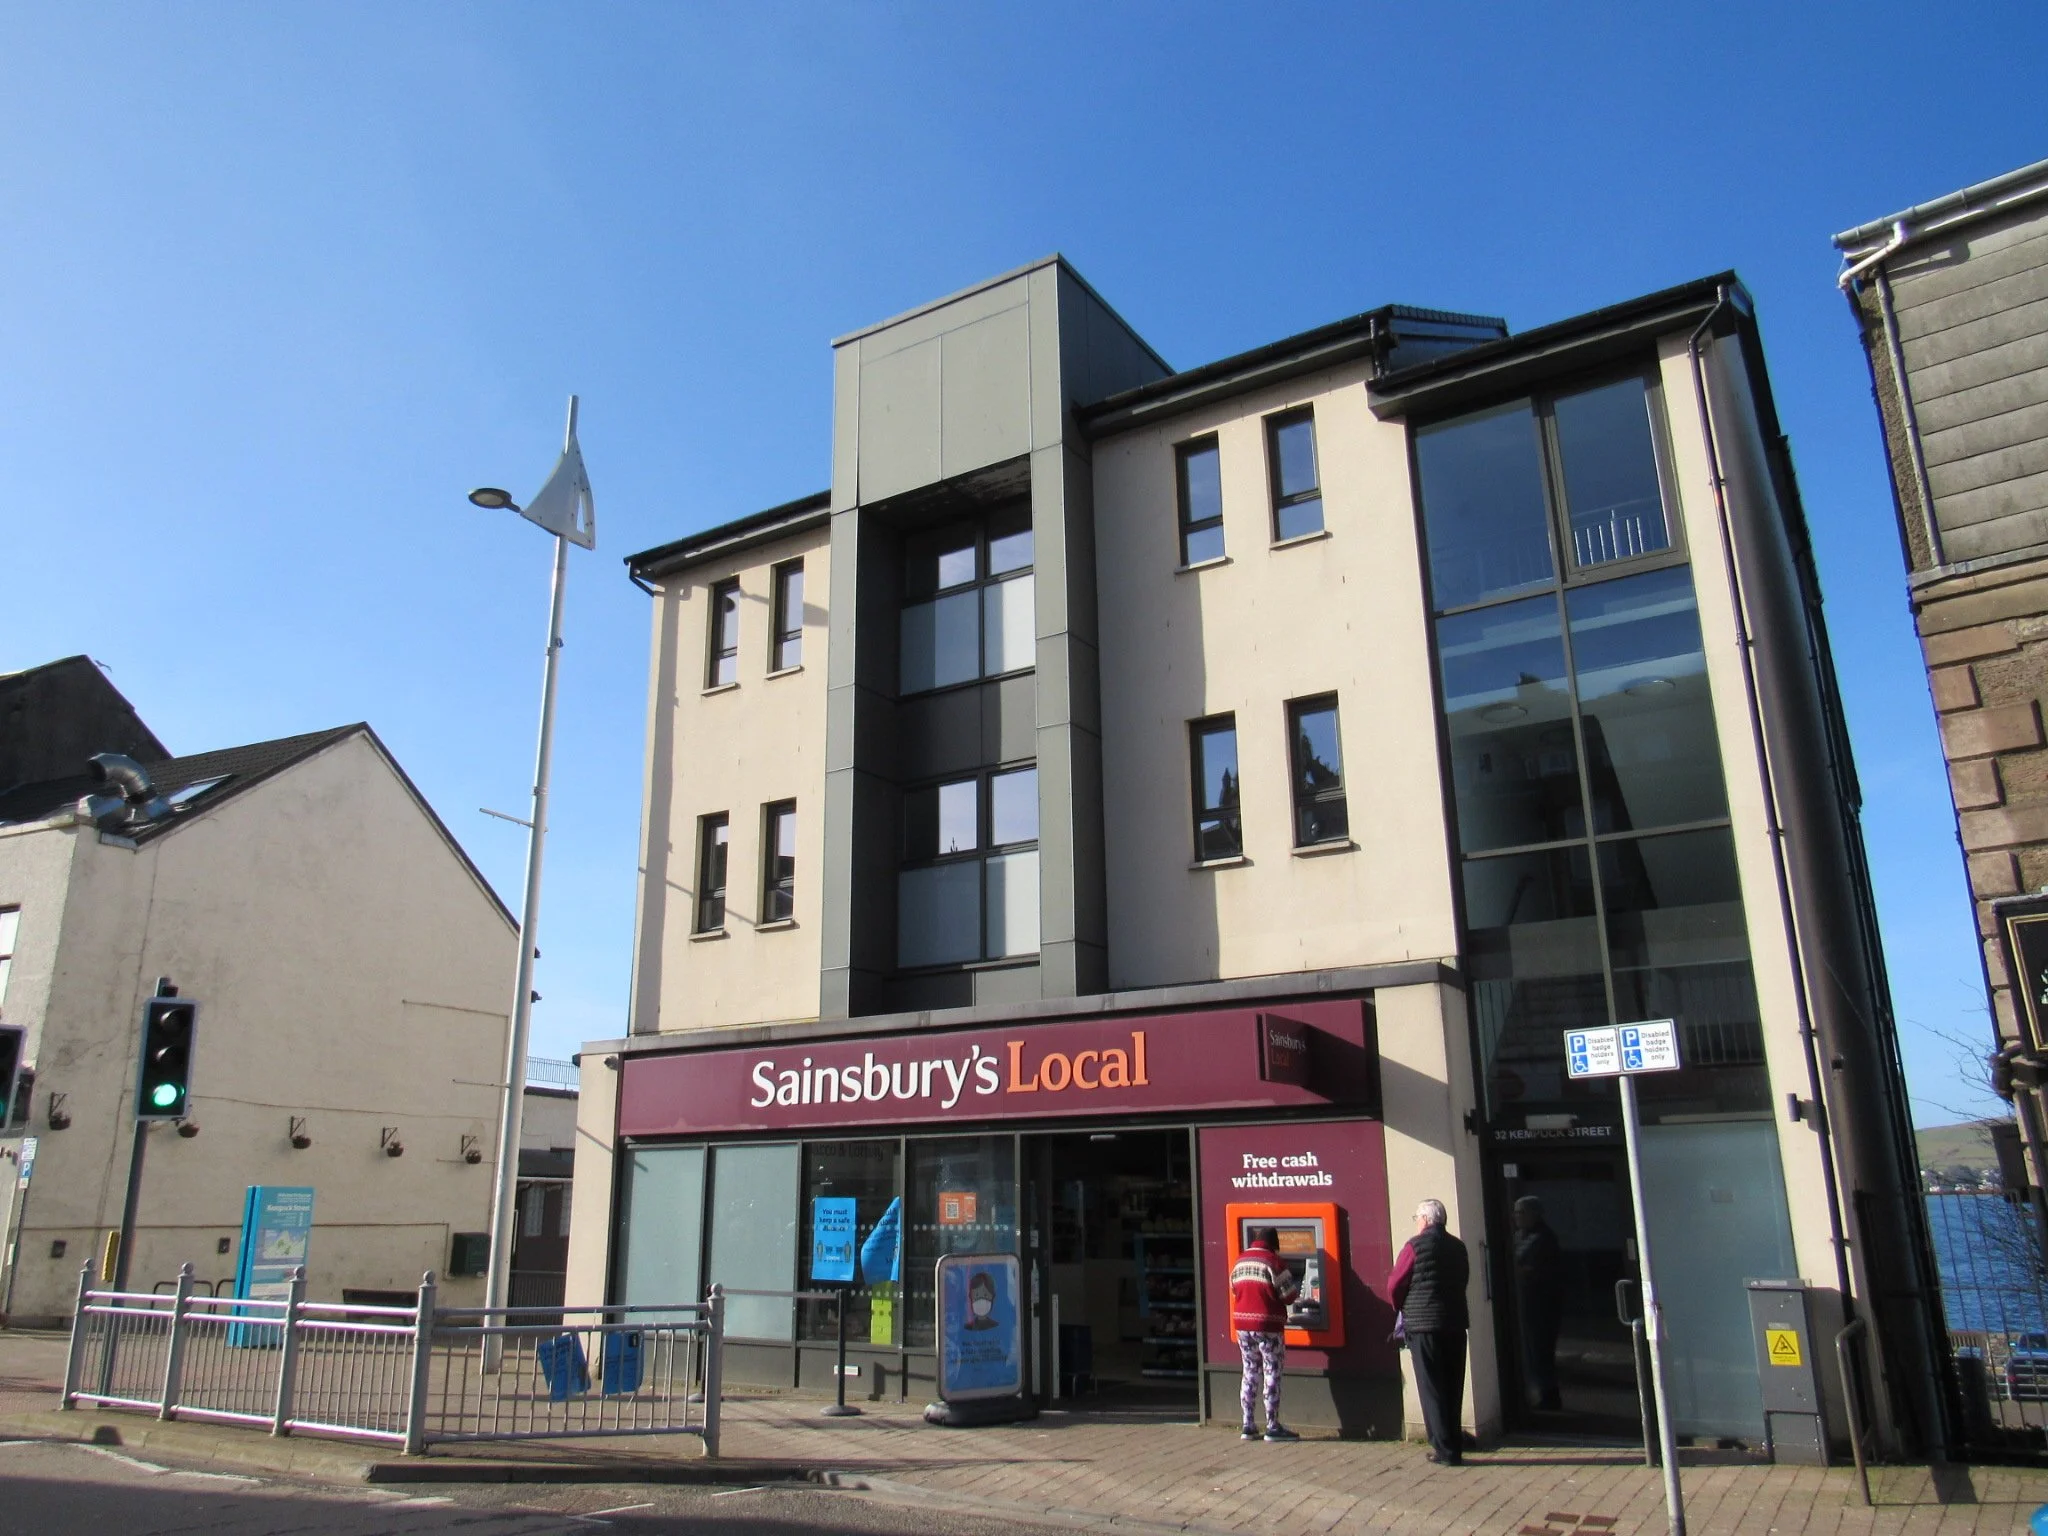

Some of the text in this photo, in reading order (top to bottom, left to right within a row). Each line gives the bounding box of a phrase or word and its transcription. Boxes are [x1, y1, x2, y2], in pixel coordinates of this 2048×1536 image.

[1588, 1036, 1614, 1044] Disabled
[1625, 1030, 1636, 1046] P
[1641, 1030, 1669, 1038] Disabled
[1573, 1037, 1583, 1052] P
[751, 1031, 1149, 1109] Sainsbury's Local
[1495, 1130, 1507, 1140] 32
[1568, 1126, 1612, 1137] STREET
[1242, 1151, 1318, 1168] Free cash
[1231, 1171, 1333, 1188] withdrawals
